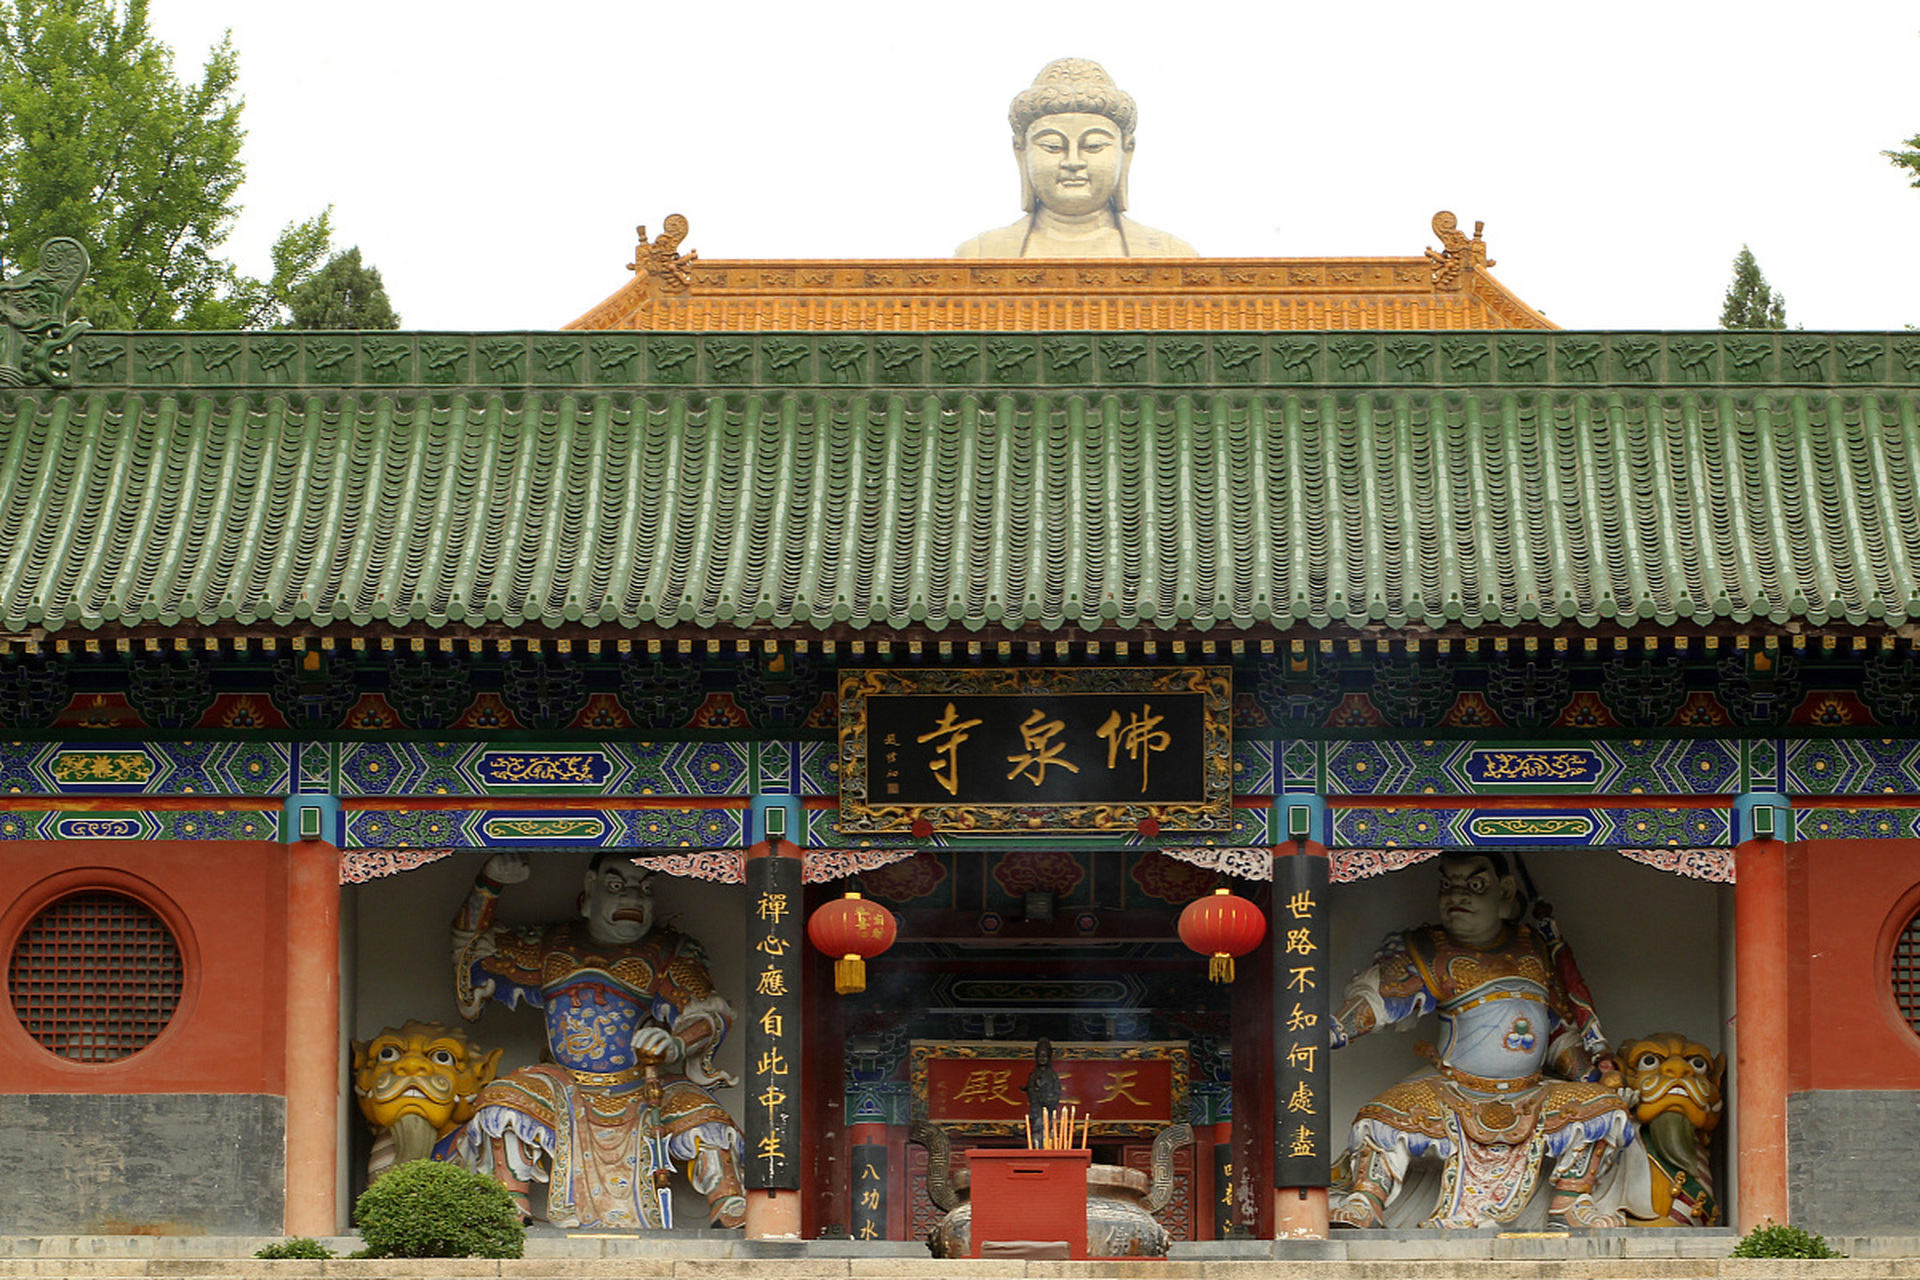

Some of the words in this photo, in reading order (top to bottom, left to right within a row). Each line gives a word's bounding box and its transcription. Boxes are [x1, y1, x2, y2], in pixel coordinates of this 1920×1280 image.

[916, 701, 1172, 796] 佛泉寺
[755, 890, 792, 1160] 禪心應自此中生
[1285, 889, 1319, 1159] 世路不知何處盡
[860, 1163, 881, 1241] 八功水
